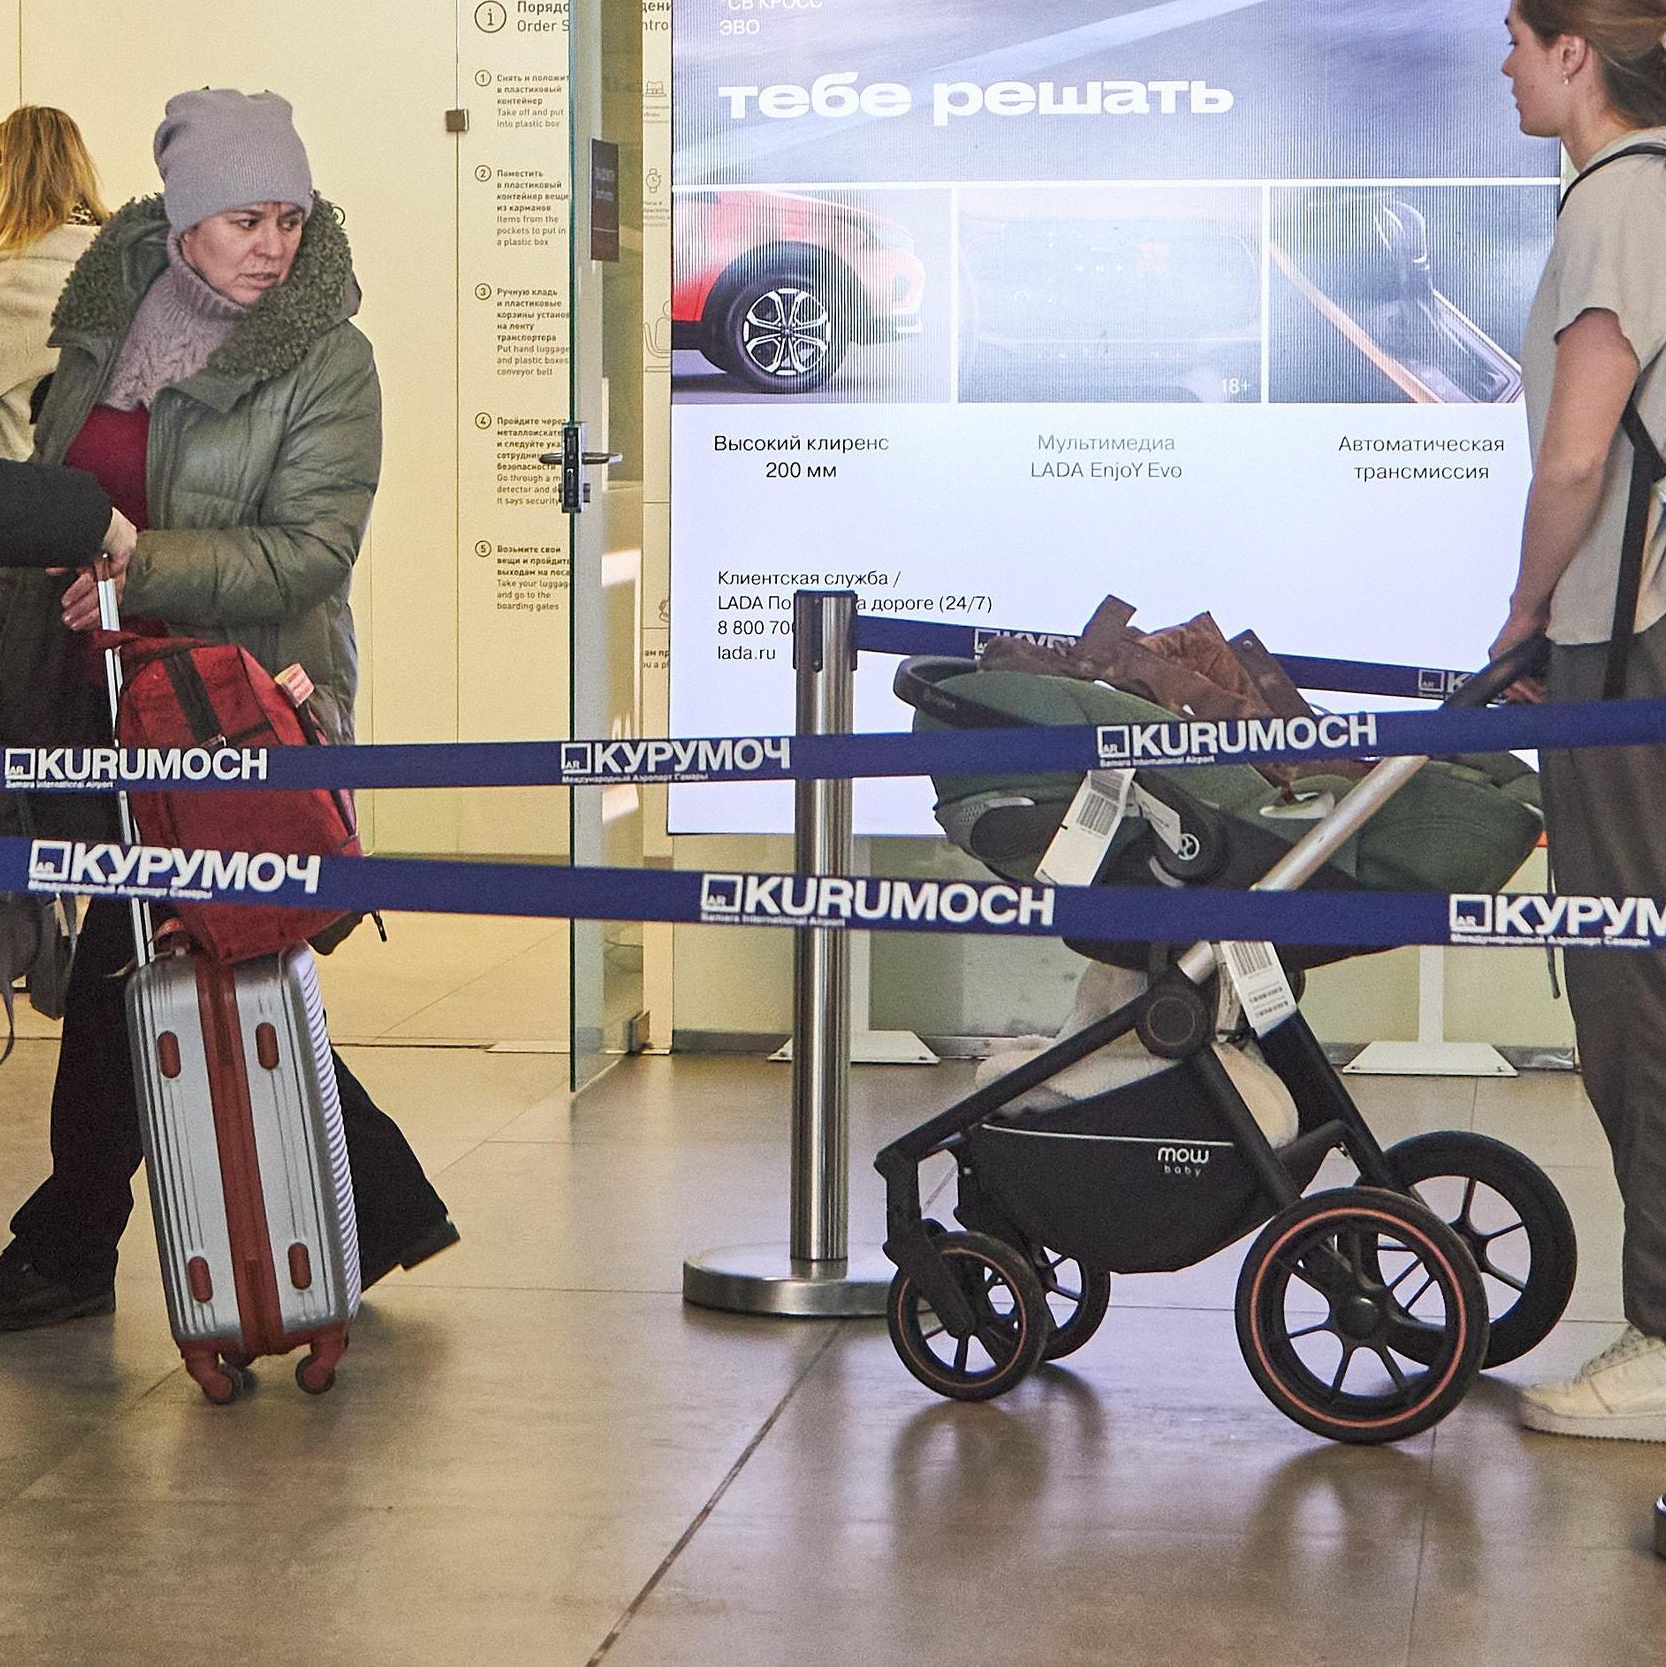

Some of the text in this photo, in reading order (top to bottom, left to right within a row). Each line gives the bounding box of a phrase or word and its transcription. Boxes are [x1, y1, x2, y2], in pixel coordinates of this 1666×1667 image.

[517, 1, 569, 15] Порядо
[517, 20, 557, 32] Order
[719, 18, 760, 35] ЭВО
[718, 71, 1233, 126] тебе решать
[1219, 377, 1251, 395] 18+
[714, 433, 889, 454] Высокий клиренс
[1037, 434, 1176, 456] Мультимедиа
[1338, 434, 1505, 453] Автоматическая
[765, 462, 838, 478] 200 мм
[1030, 461, 1183, 481] LADA EnjoY Evo
[1354, 464, 1490, 483] трансмиссия
[717, 570, 819, 586] Клиентская
[824, 570, 888, 589] служба
[717, 596, 763, 610] LADA
[871, 595, 993, 614] дороге (24/7)
[717, 621, 727, 635] 8
[732, 620, 764, 635] 800
[717, 645, 776, 660] lada.ru
[1131, 713, 1377, 757] KURUMOCH
[37, 748, 268, 781] KURUMOCH
[593, 737, 790, 773] КУРУМОЧ
[71, 842, 321, 894] КУРУМОЧ
[743, 874, 1056, 926] KURUMOCH
[1157, 1146, 1210, 1165] mow
[1164, 1166, 1202, 1177] baby
